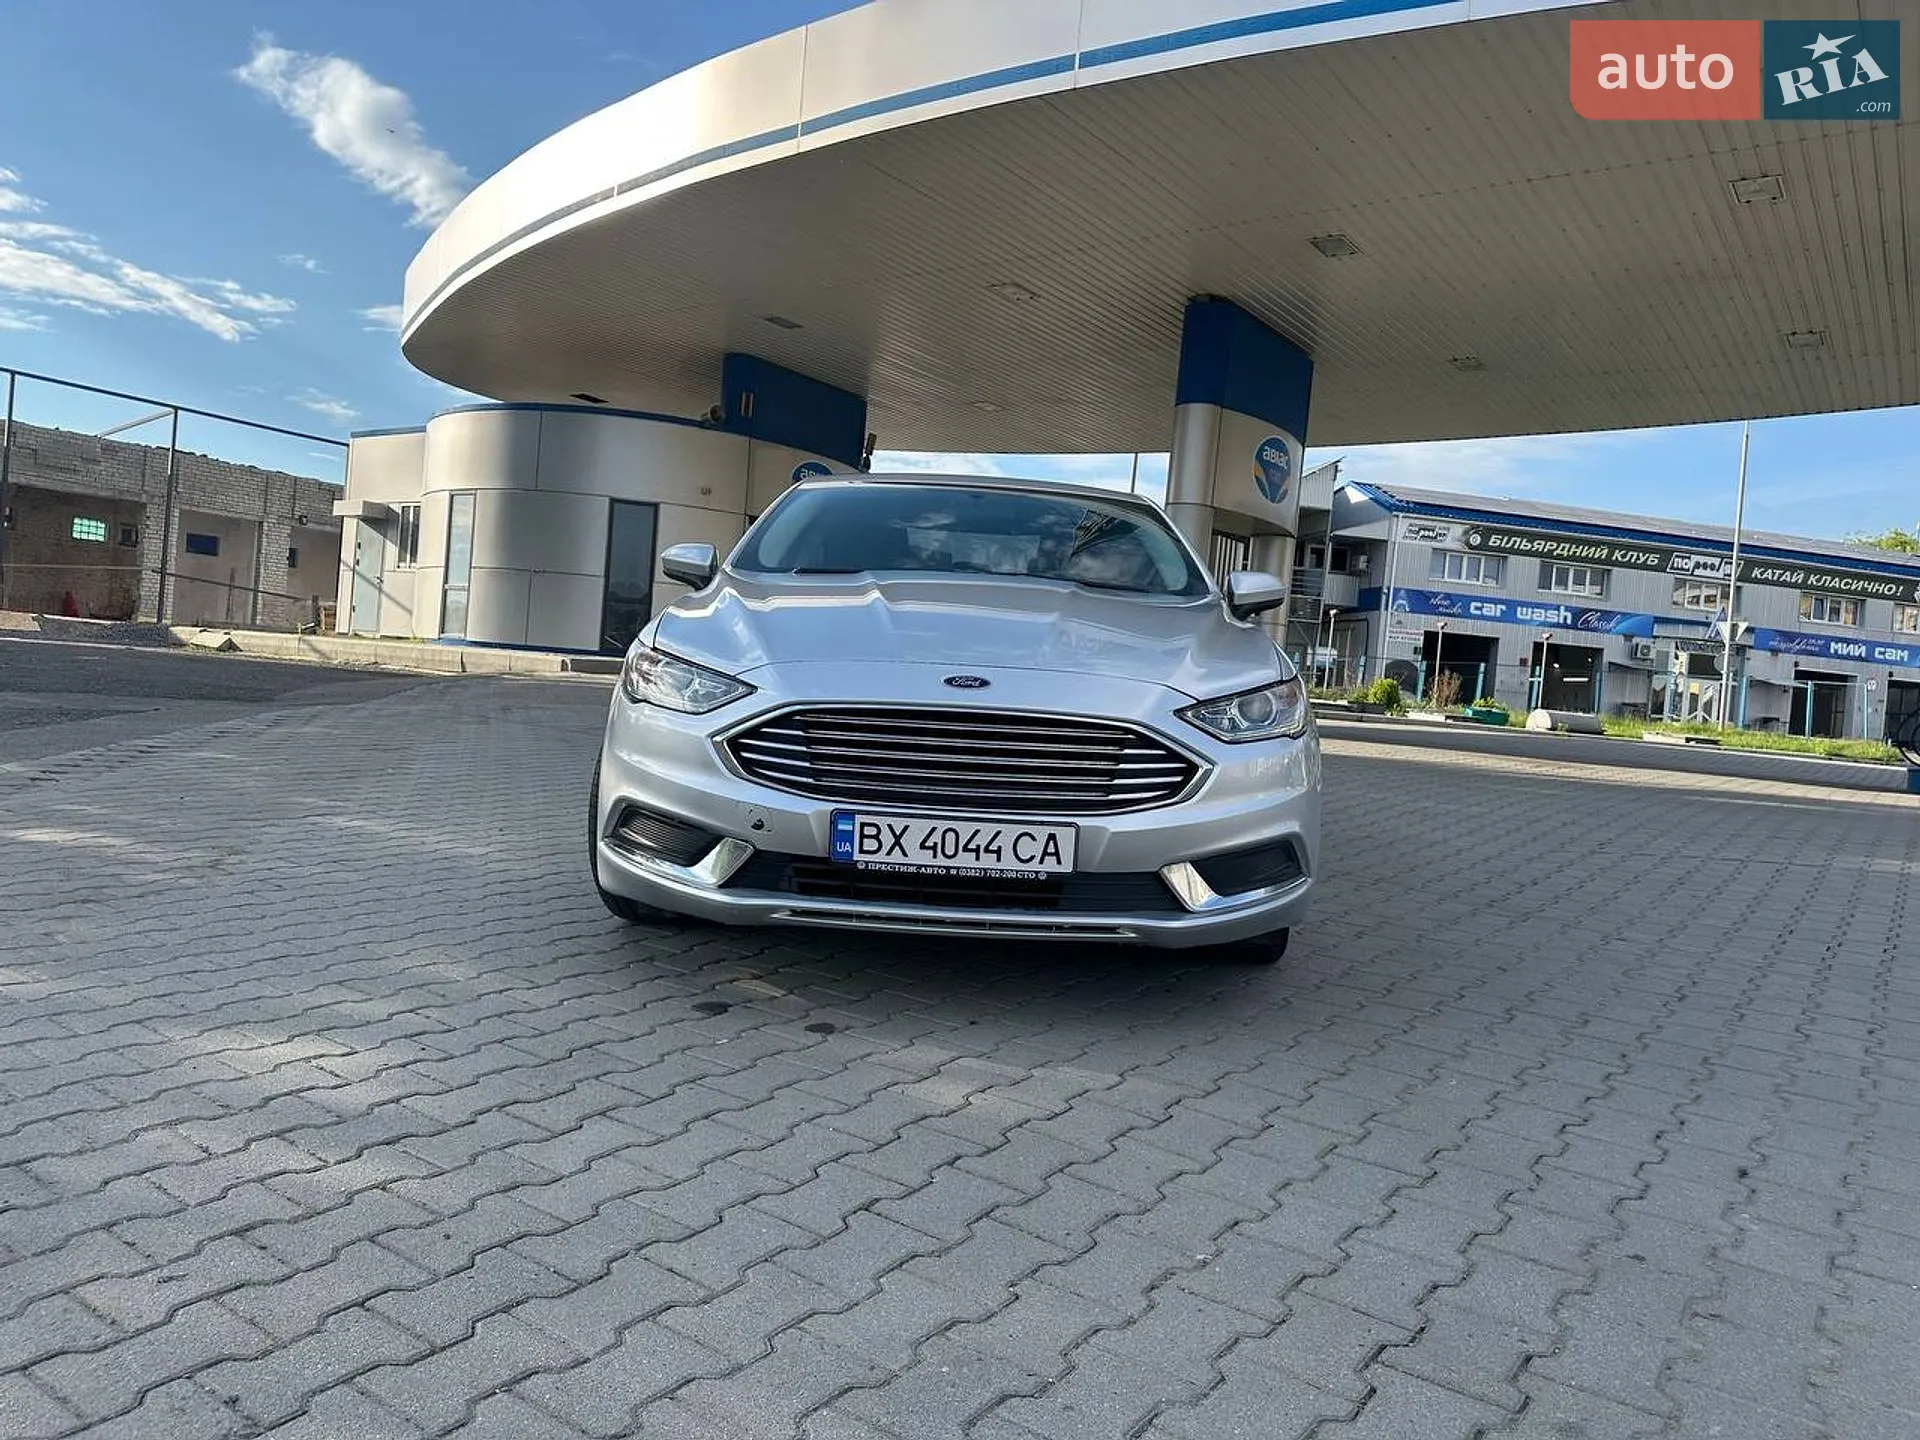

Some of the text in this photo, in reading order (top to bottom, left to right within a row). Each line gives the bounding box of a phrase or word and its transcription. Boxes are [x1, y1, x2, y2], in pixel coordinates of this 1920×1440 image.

[1488, 535, 1660, 566] БІЛЬЯРДНИЙ КЛУБ
[1751, 567, 1805, 584] КАТАЙ
[1807, 573, 1904, 597] КЛАСИЧНО!
[1469, 600, 1507, 617] car
[1516, 605, 1572, 625] wash
[836, 841, 851, 853] UA
[858, 821, 1063, 866] BX 4044 CA
